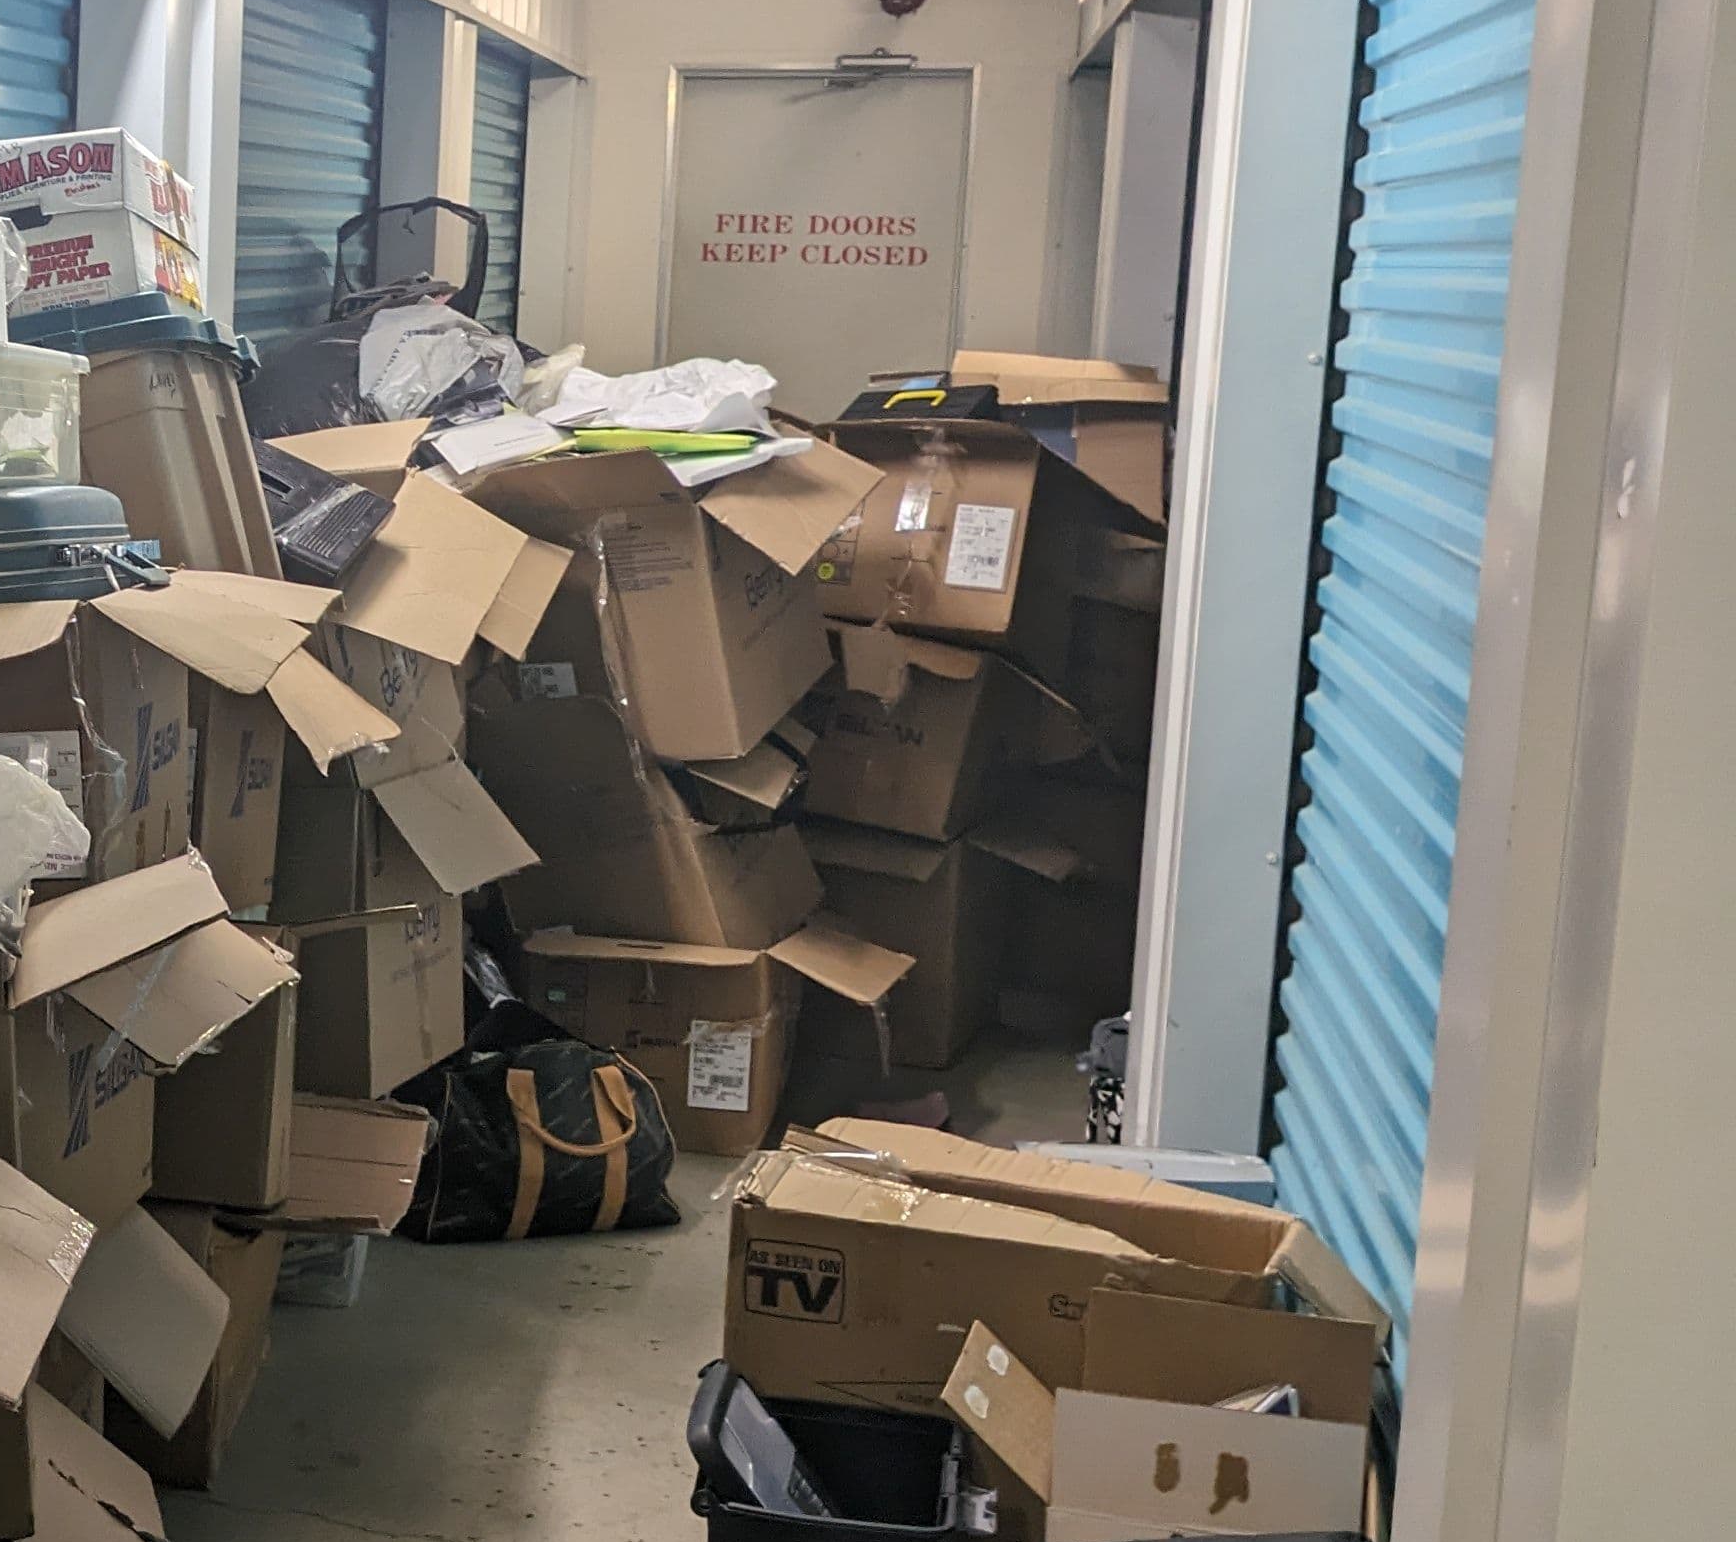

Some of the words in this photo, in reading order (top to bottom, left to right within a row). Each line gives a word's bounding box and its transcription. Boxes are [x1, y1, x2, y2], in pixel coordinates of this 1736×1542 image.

[715, 213, 793, 234] FIRE
[809, 215, 918, 236] DOORS
[701, 242, 788, 263] KEEP
[800, 244, 929, 266] CLOSED
[57, 261, 111, 285] PAPER
[746, 1265, 841, 1314] TV
